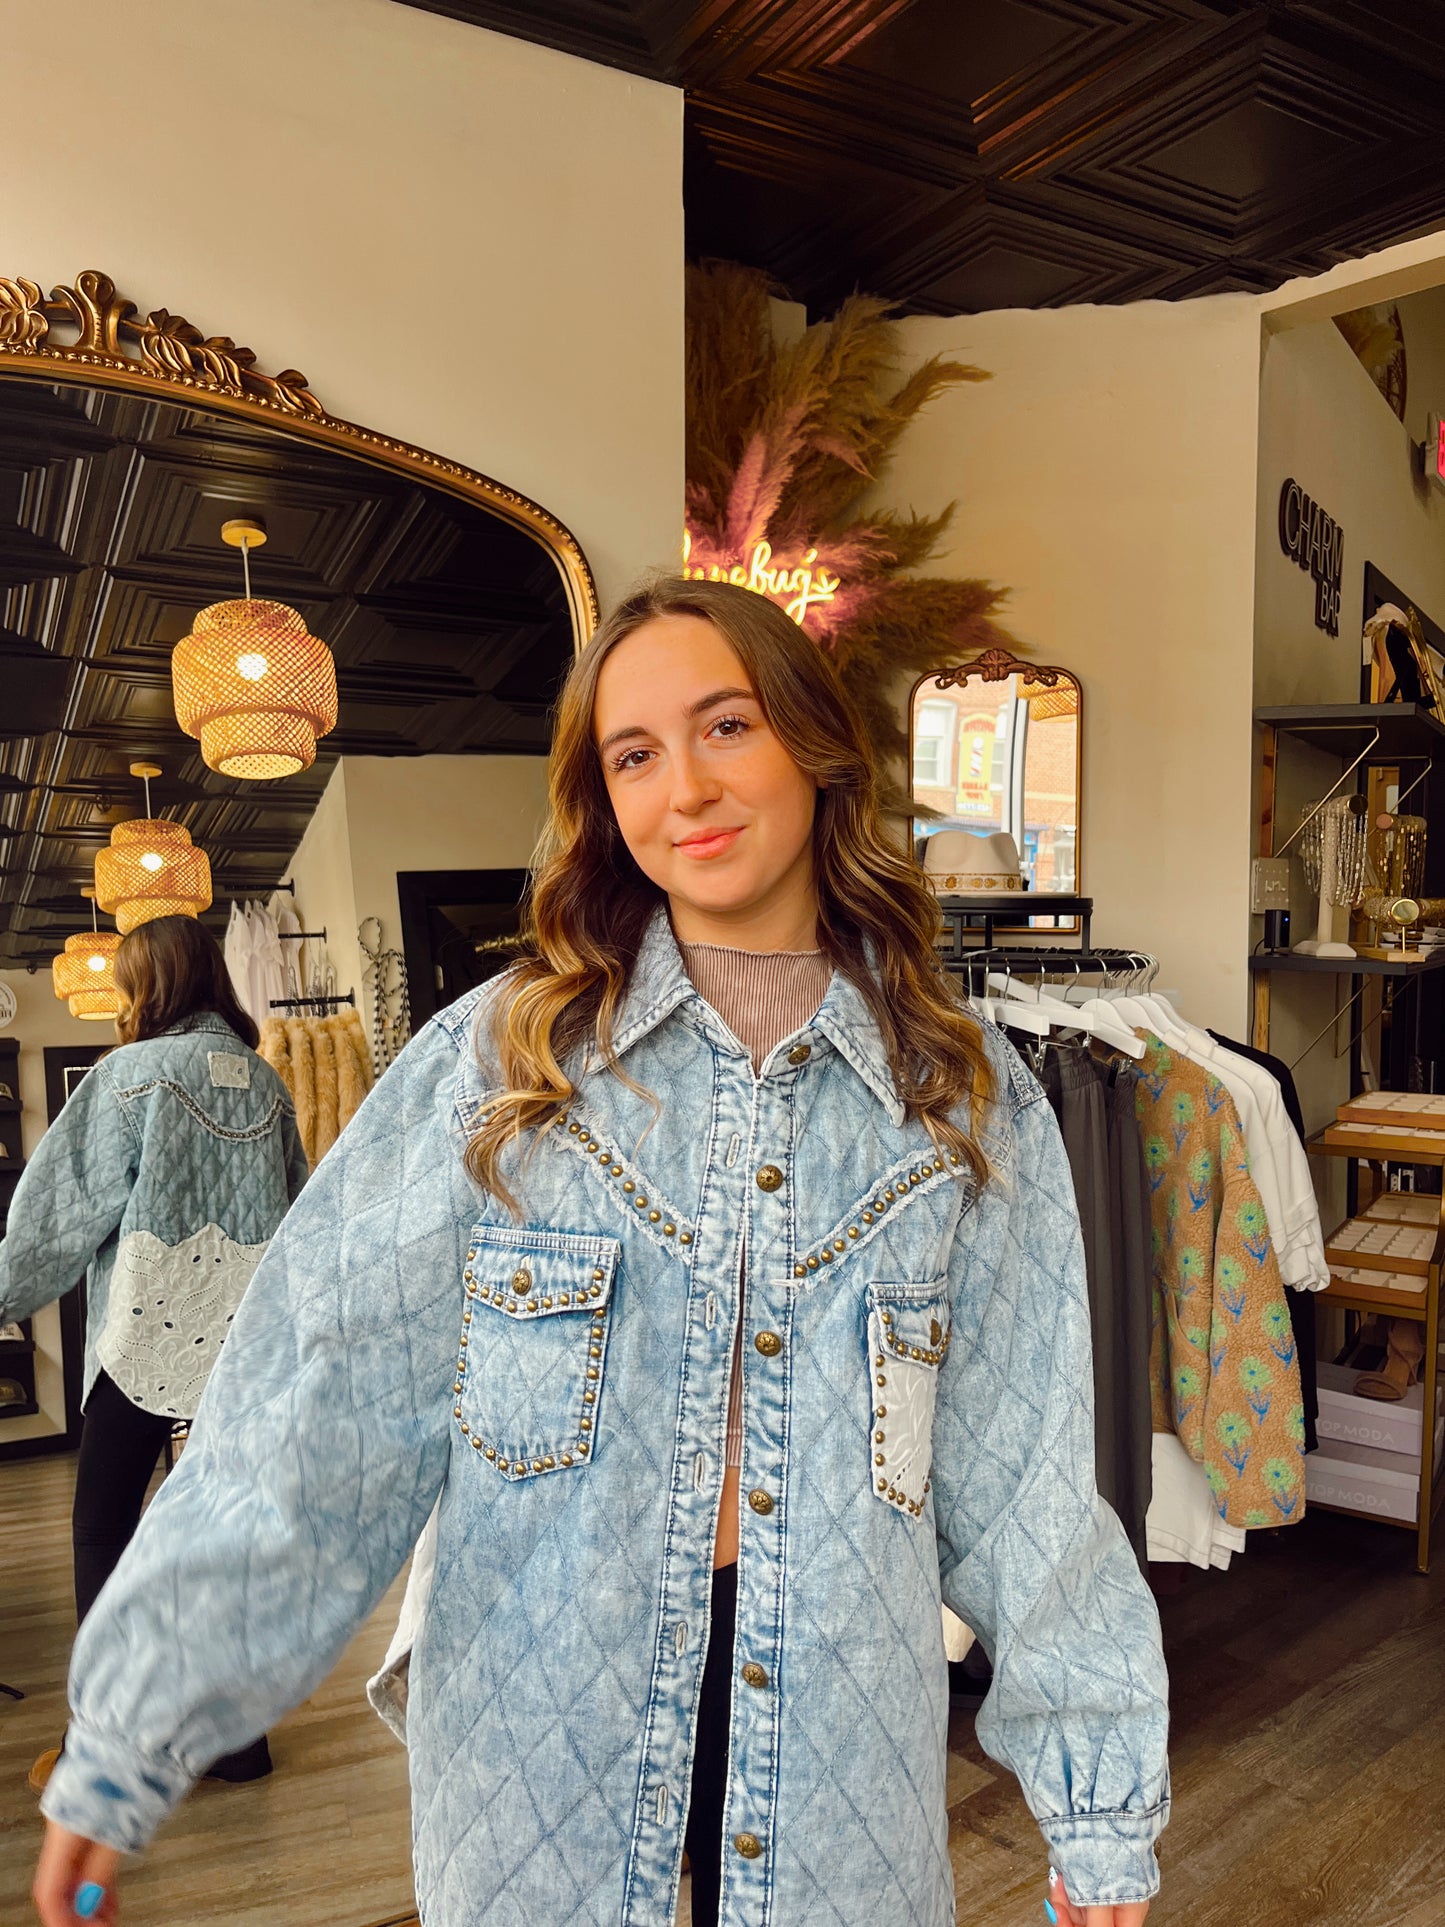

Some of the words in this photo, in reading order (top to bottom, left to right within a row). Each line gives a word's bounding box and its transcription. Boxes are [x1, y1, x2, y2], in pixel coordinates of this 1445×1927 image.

[1279, 478, 1344, 588] CHARM
[1316, 580, 1341, 638] BAR
[1343, 1424, 1395, 1445] MODA
[1338, 1488, 1391, 1511] MODA
